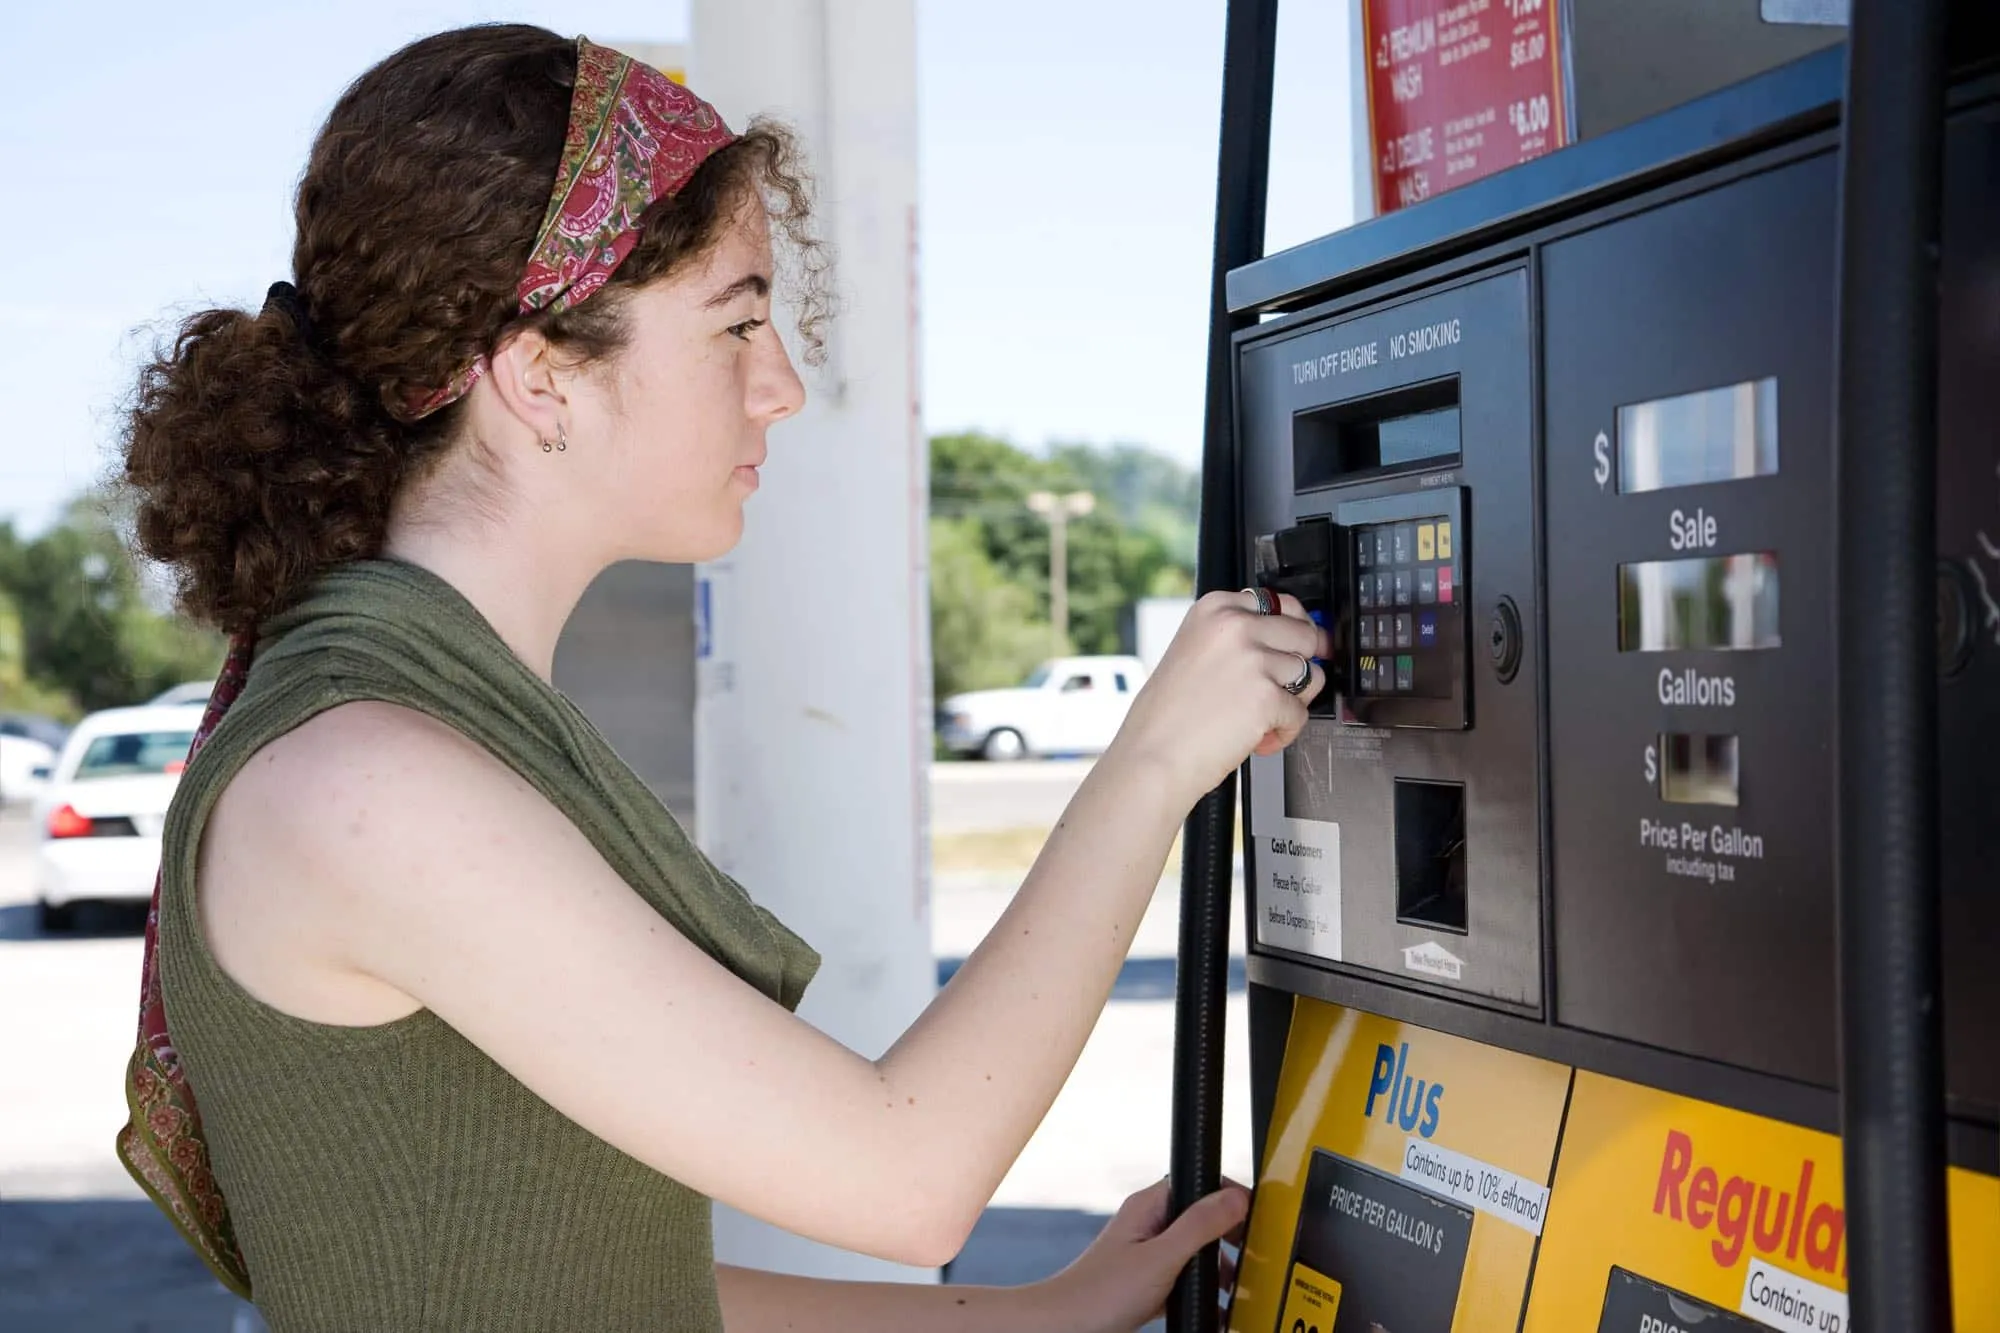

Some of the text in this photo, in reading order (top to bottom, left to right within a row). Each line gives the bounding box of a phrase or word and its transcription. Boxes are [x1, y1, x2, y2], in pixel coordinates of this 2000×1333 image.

[1390, 63, 1424, 104] WASH
[1390, 319, 1461, 361] NO SMOKING
[1292, 341, 1378, 385] TURN OFF ENGINE
[1594, 428, 1610, 490] $
[1669, 507, 1717, 551] Sale
[1658, 667, 1736, 706] Gallons
[1644, 744, 1657, 784] $
[1271, 837, 1323, 859] Cash Customers
[1640, 818, 1763, 859] Price Per Gallon
[1666, 853, 1735, 885] including tax
[1364, 1042, 1444, 1138] Plus
[1406, 1144, 1544, 1222] Contains up to 10% ethanol
[1653, 1128, 1848, 1279] Regula
[1329, 1184, 1362, 1219] PRICE
[1362, 1197, 1385, 1229] PER
[1386, 1208, 1434, 1248] GALLON
[1750, 1271, 1840, 1333] Contains up
